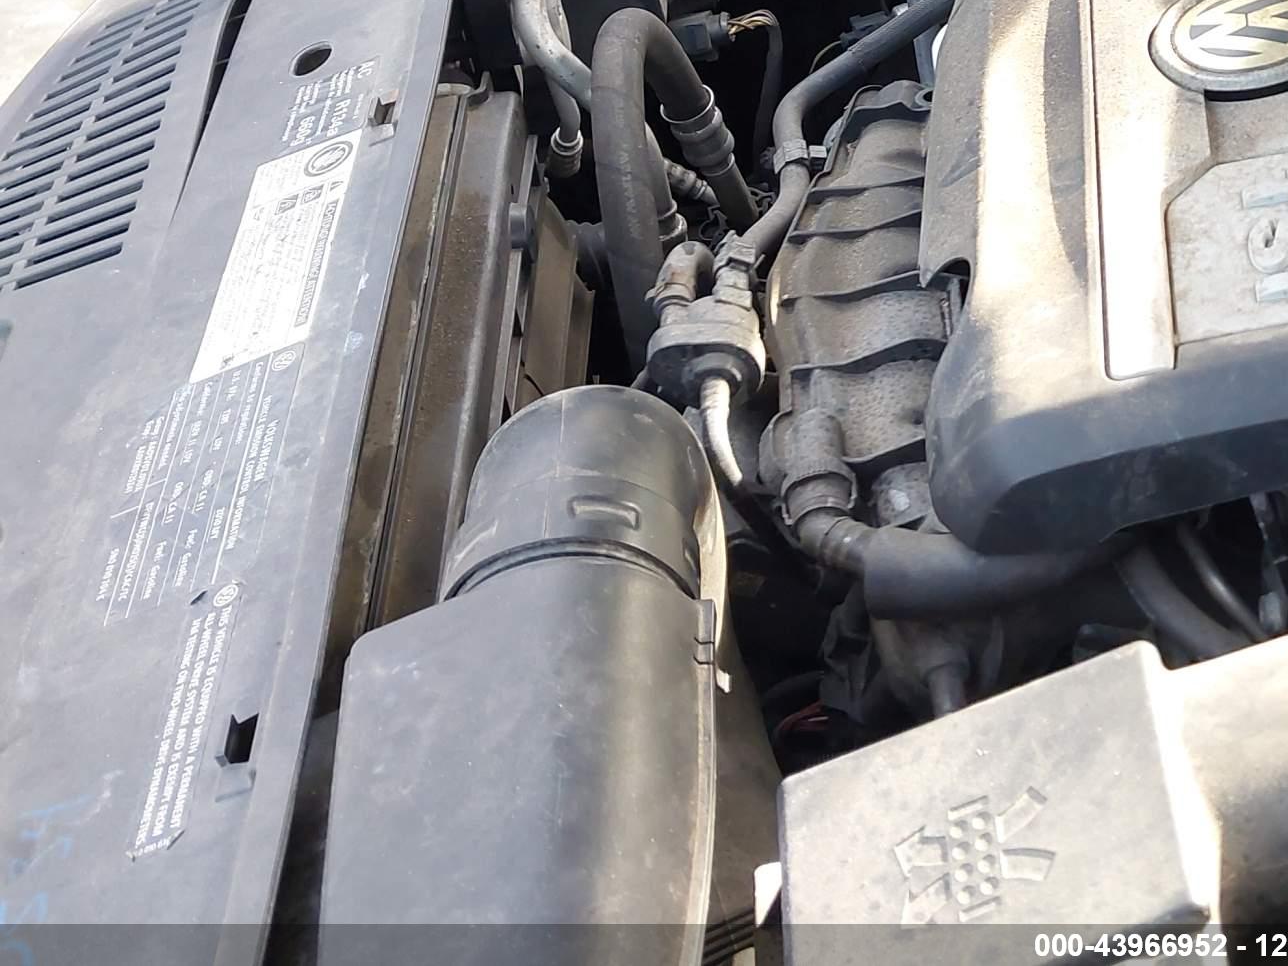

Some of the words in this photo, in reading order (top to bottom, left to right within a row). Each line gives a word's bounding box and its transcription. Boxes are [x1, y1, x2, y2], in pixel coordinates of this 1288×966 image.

[357, 61, 375, 78] AC
[326, 100, 350, 137] R134a
[258, 395, 272, 423] VEHICLE
[254, 420, 278, 481] VOLKSWAGEN
[240, 461, 255, 494] CONTROL
[225, 496, 246, 549] INFORMATION
[219, 605, 232, 626] THIS
[180, 635, 197, 669] TESTING
[196, 612, 216, 661] ALL-WHEEL
[209, 626, 226, 665] VEHICLE
[189, 661, 204, 688] DRIVE
[163, 684, 184, 739] TWO-WHEEL
[180, 690, 197, 726] SYSTEM
[195, 676, 214, 724] EQUIPPED
[156, 739, 170, 767] DRIVE
[175, 728, 186, 750] AND
[188, 725, 203, 753] WITH
[161, 763, 179, 802] EXEMPT
[170, 765, 193, 828] PERMANENT
[135, 767, 163, 848] DYNAMOMETERS.
[152, 805, 168, 836] FROM
